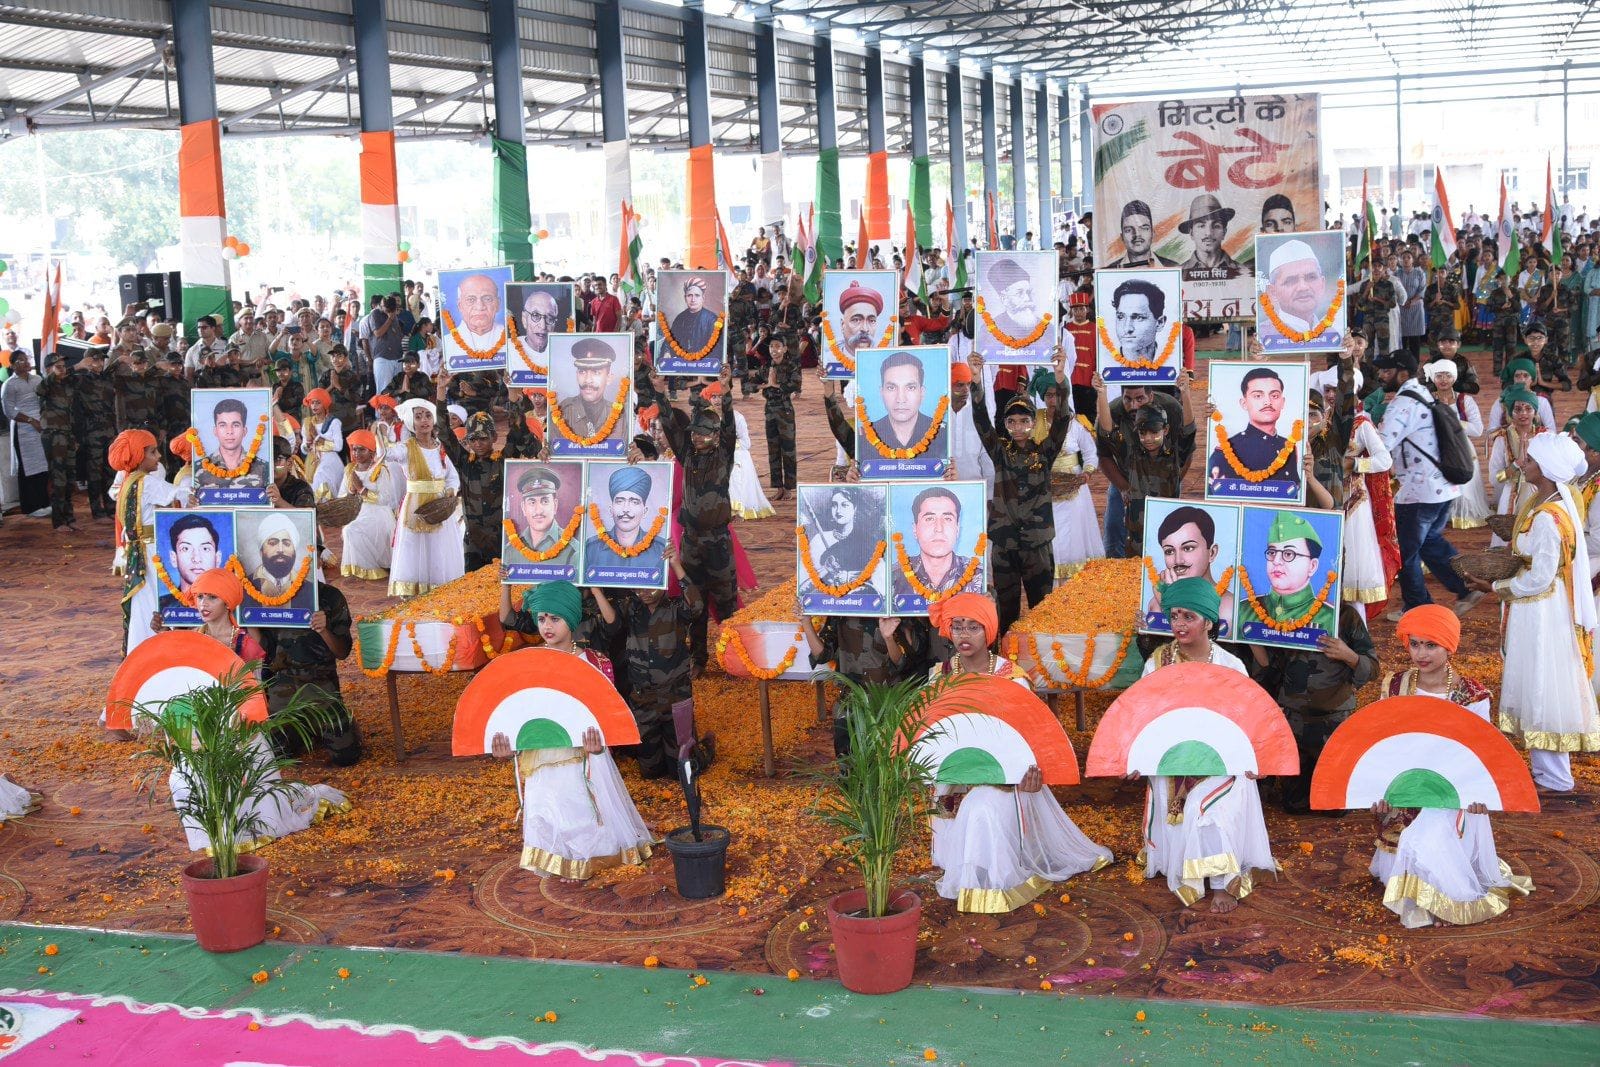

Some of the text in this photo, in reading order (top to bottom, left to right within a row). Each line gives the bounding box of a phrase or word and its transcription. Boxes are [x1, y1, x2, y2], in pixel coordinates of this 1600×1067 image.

[1158, 94, 1287, 130] मिट्टी के
[1156, 127, 1292, 192] बेटे
[1189, 267, 1228, 279] भगत सिंह
[1240, 483, 1262, 492] विजयंत
[222, 492, 238, 501] अनुज
[517, 567, 530, 575] मेजर
[637, 569, 650, 579] सिंह
[822, 597, 863, 606] रानी लक्ष्मीबाई
[282, 611, 294, 619] सिंह
[1296, 632, 1310, 640] बोस
